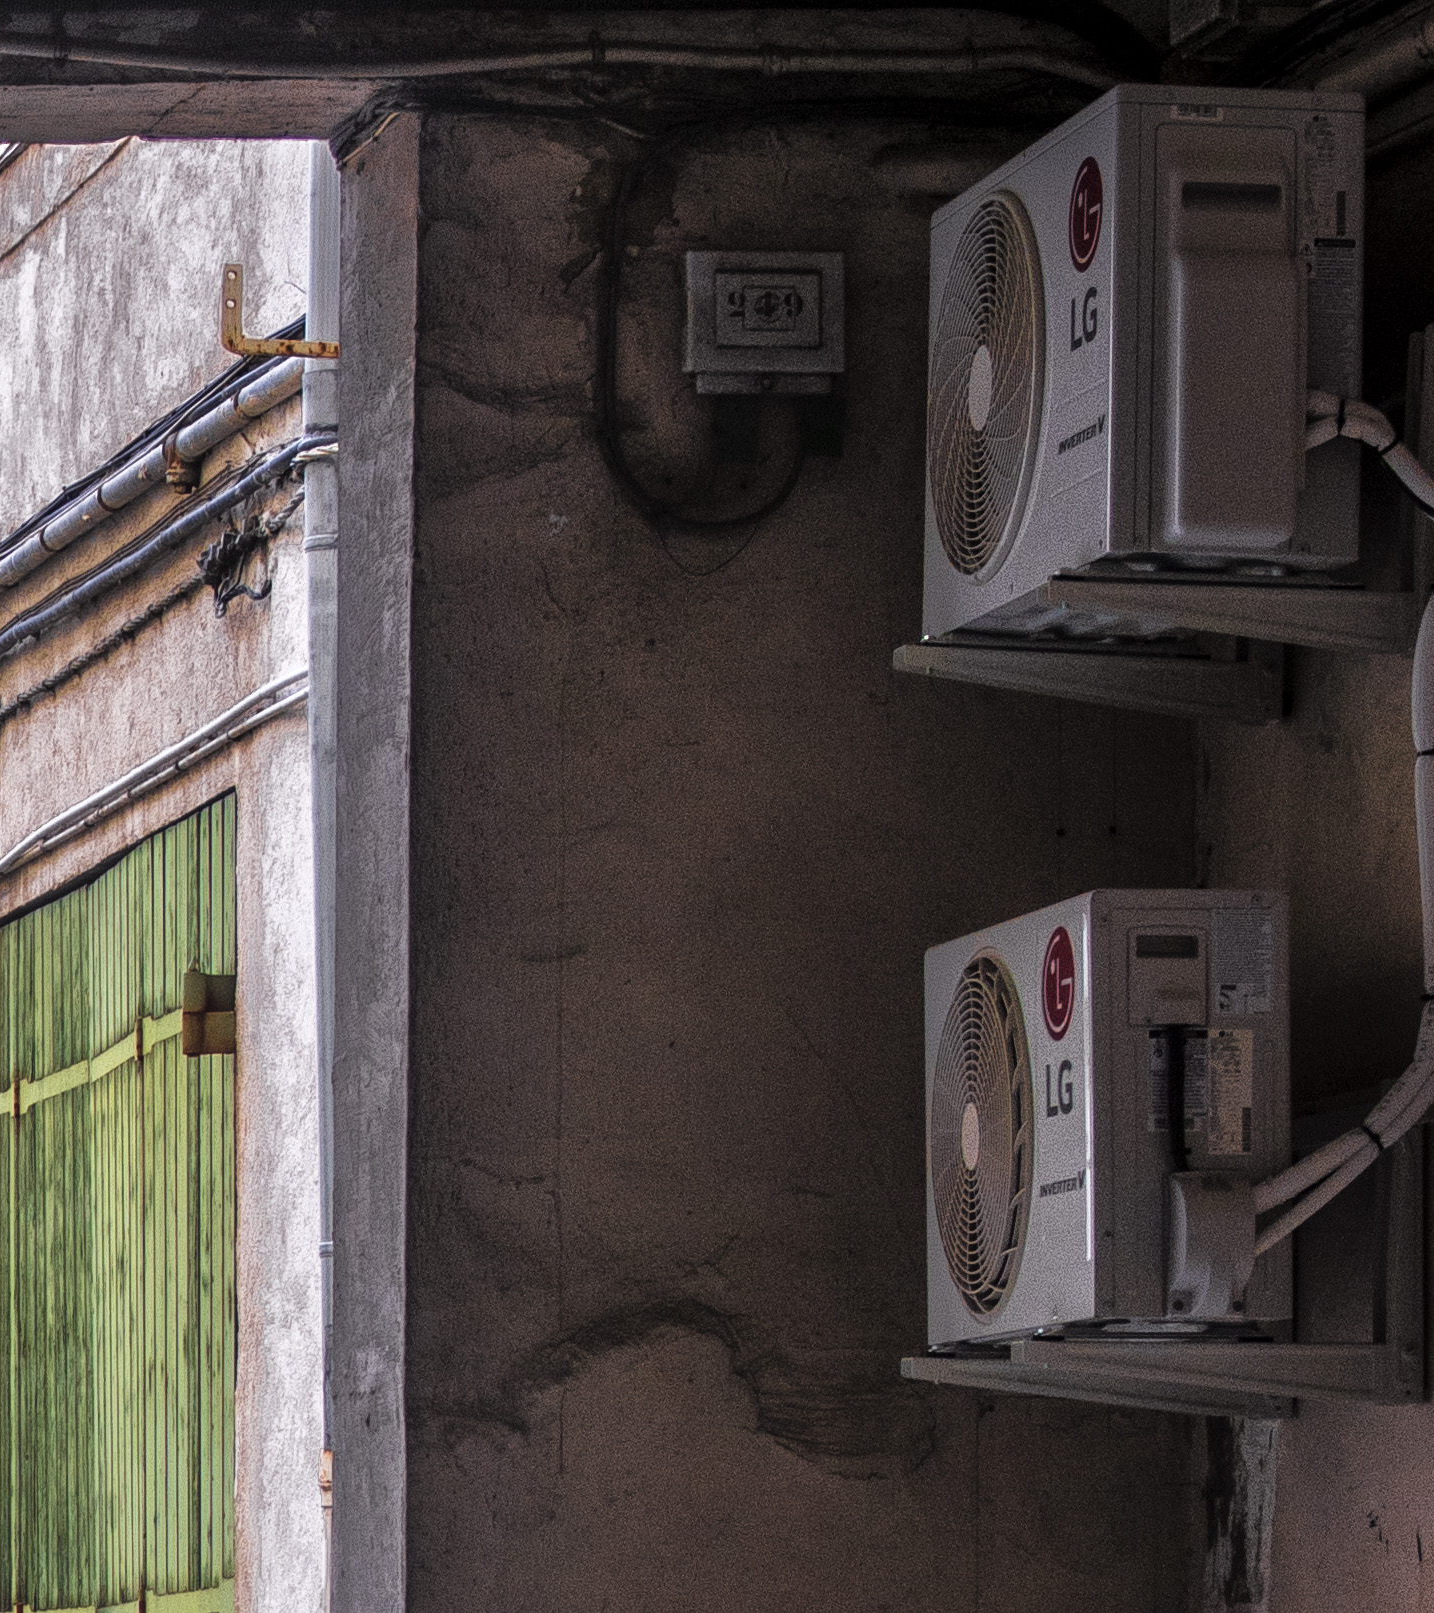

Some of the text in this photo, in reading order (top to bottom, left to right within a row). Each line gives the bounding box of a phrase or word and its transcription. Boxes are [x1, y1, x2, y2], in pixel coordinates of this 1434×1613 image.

[1070, 286, 1098, 352] LG
[1058, 421, 1097, 456] INVERTER
[1046, 1059, 1074, 1118] LG
[1039, 1177, 1078, 1198] INVERTER
